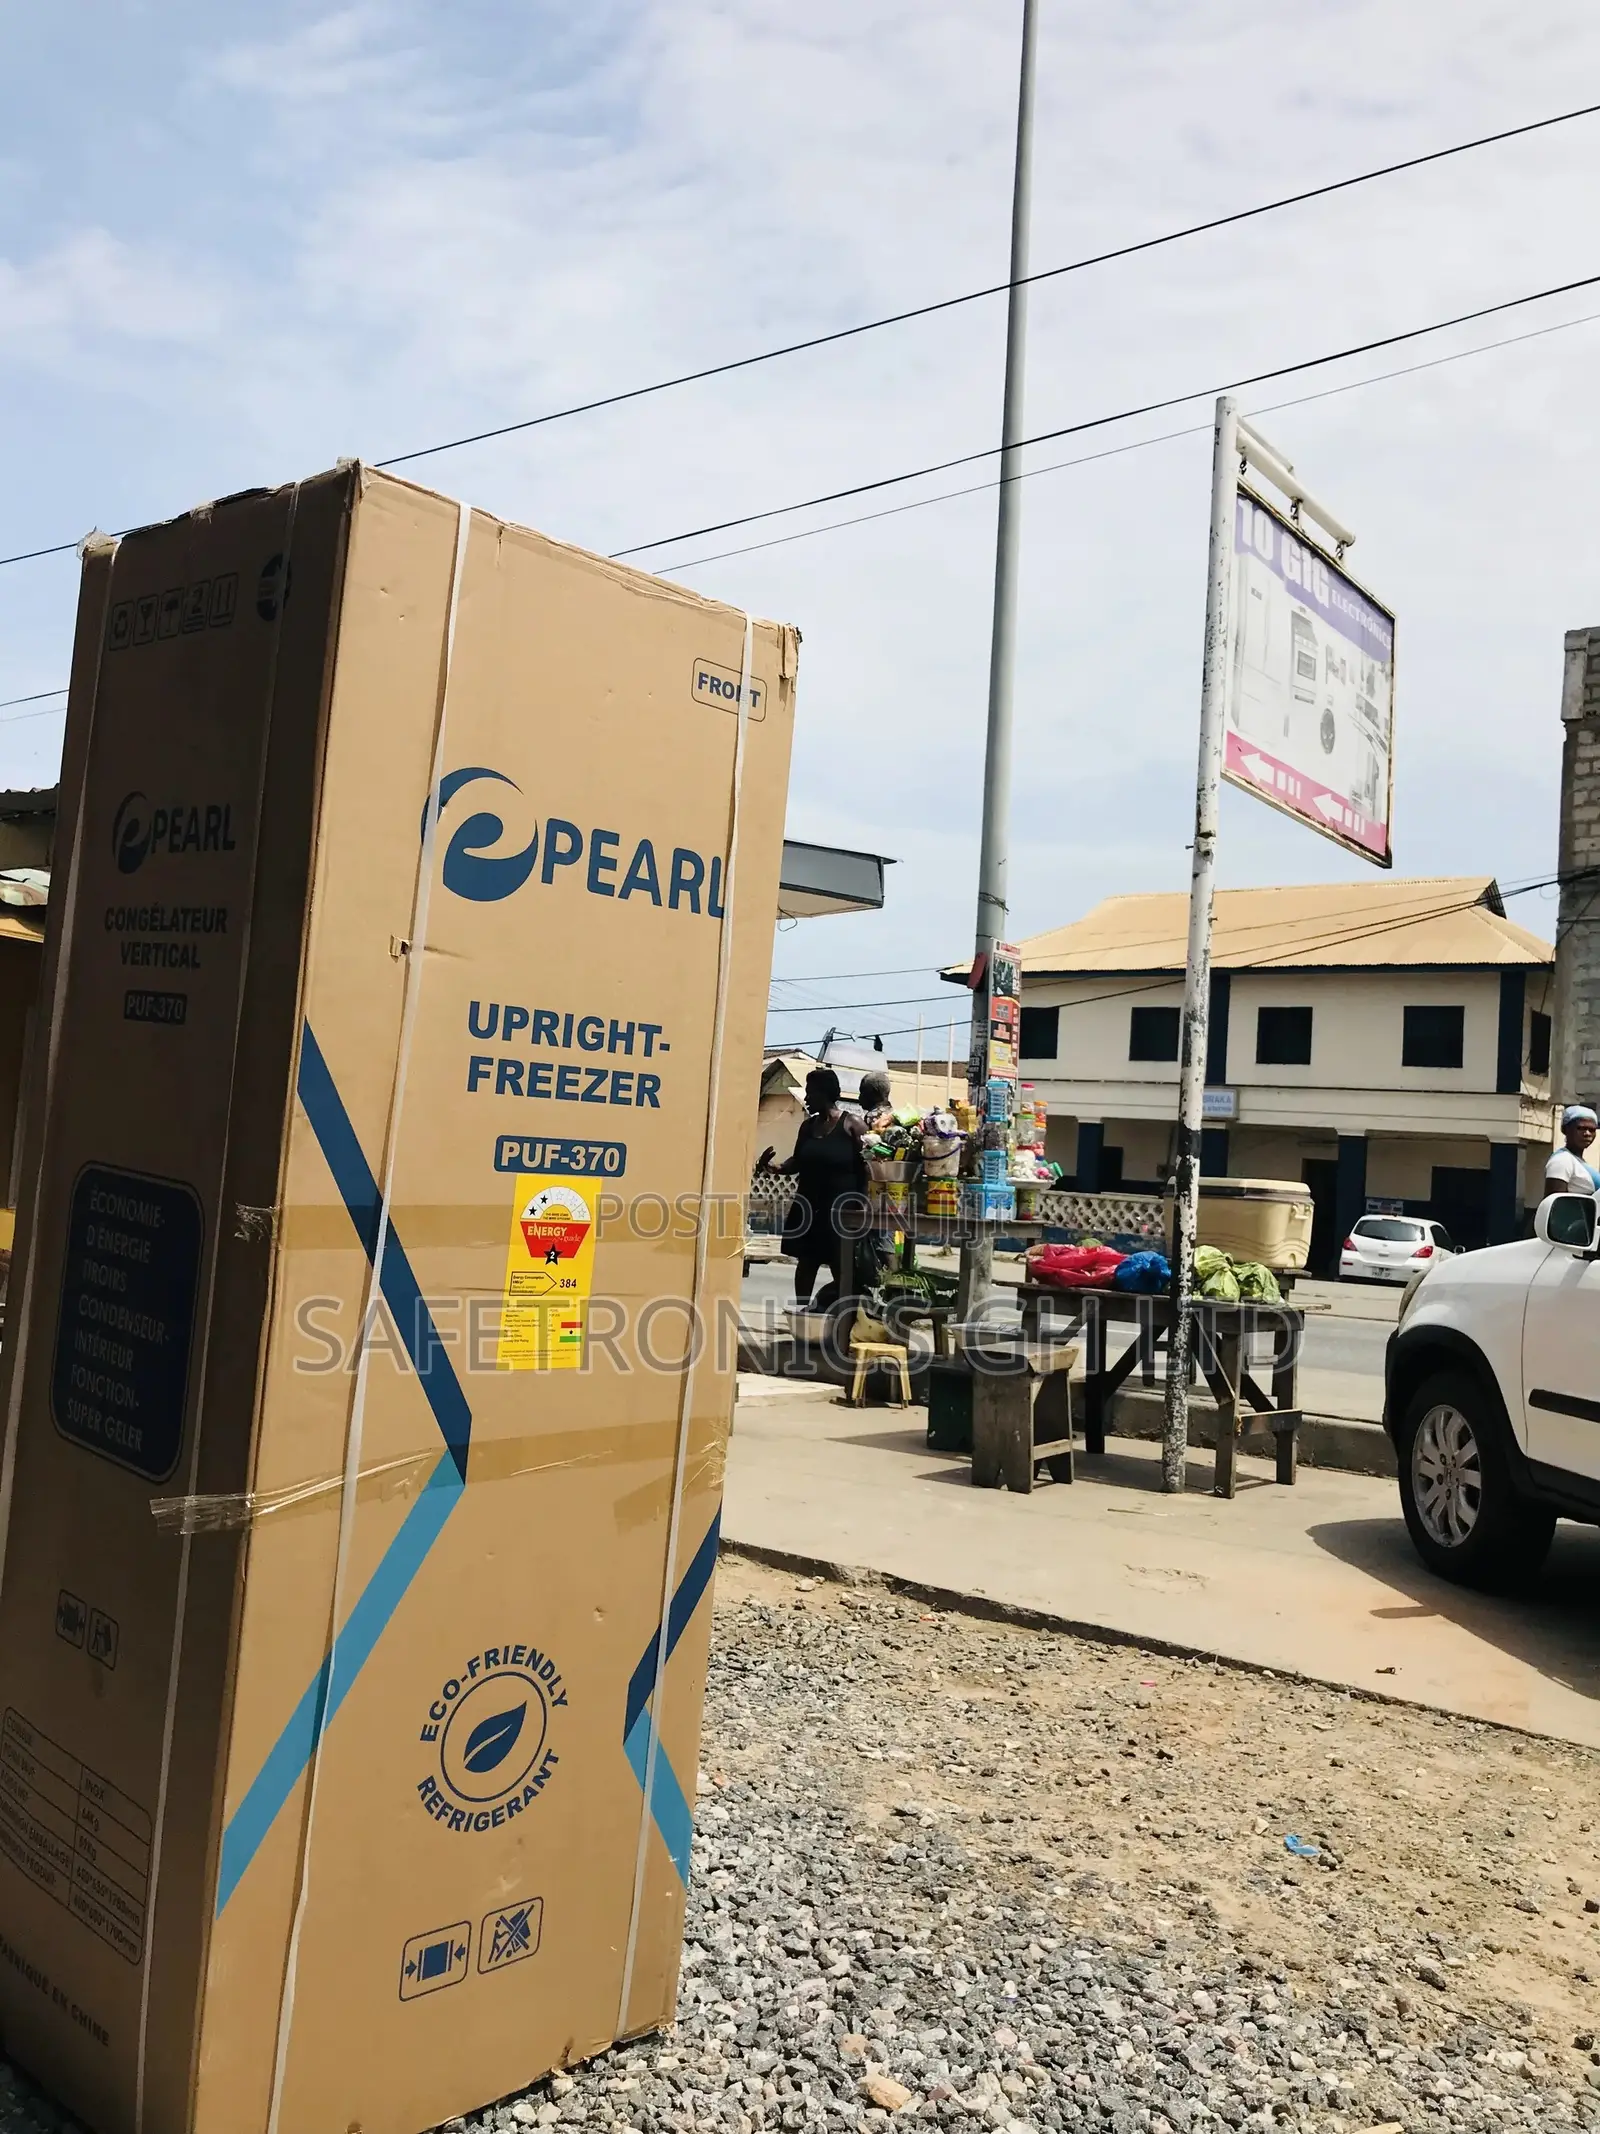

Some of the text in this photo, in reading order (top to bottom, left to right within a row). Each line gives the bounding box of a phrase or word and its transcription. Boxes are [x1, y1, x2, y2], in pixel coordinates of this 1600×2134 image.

[1237, 498, 1274, 561] 10
[151, 803, 236, 854] PEARL
[541, 817, 725, 919] PEARL
[104, 902, 228, 935] CONGÉLATEUR
[120, 940, 201, 970] VERTICAL
[126, 993, 185, 1021] PUF-370
[467, 1000, 671, 1058] UPRIGHT-
[466, 1057, 662, 1108] FREEZER
[500, 1140, 621, 1173] PUF-370
[89, 1182, 166, 1229] ÉCONOMIE-
[527, 1223, 568, 1240] ENERGY
[82, 1258, 128, 1293] TIROIRS
[549, 1251, 556, 1260] 2
[559, 1278, 577, 1289] 384
[78, 1293, 170, 1345] CONDENSEUR-
[74, 1328, 134, 1372] INTÉRIEUR
[70, 1364, 140, 1409] FONCTION-
[67, 1398, 143, 1453] SUPER GELER
[420, 1644, 568, 1743] ECO-FRIENDLY
[417, 1748, 562, 1833] REFRIGERANT
[71, 2004, 110, 2047] CHINE
